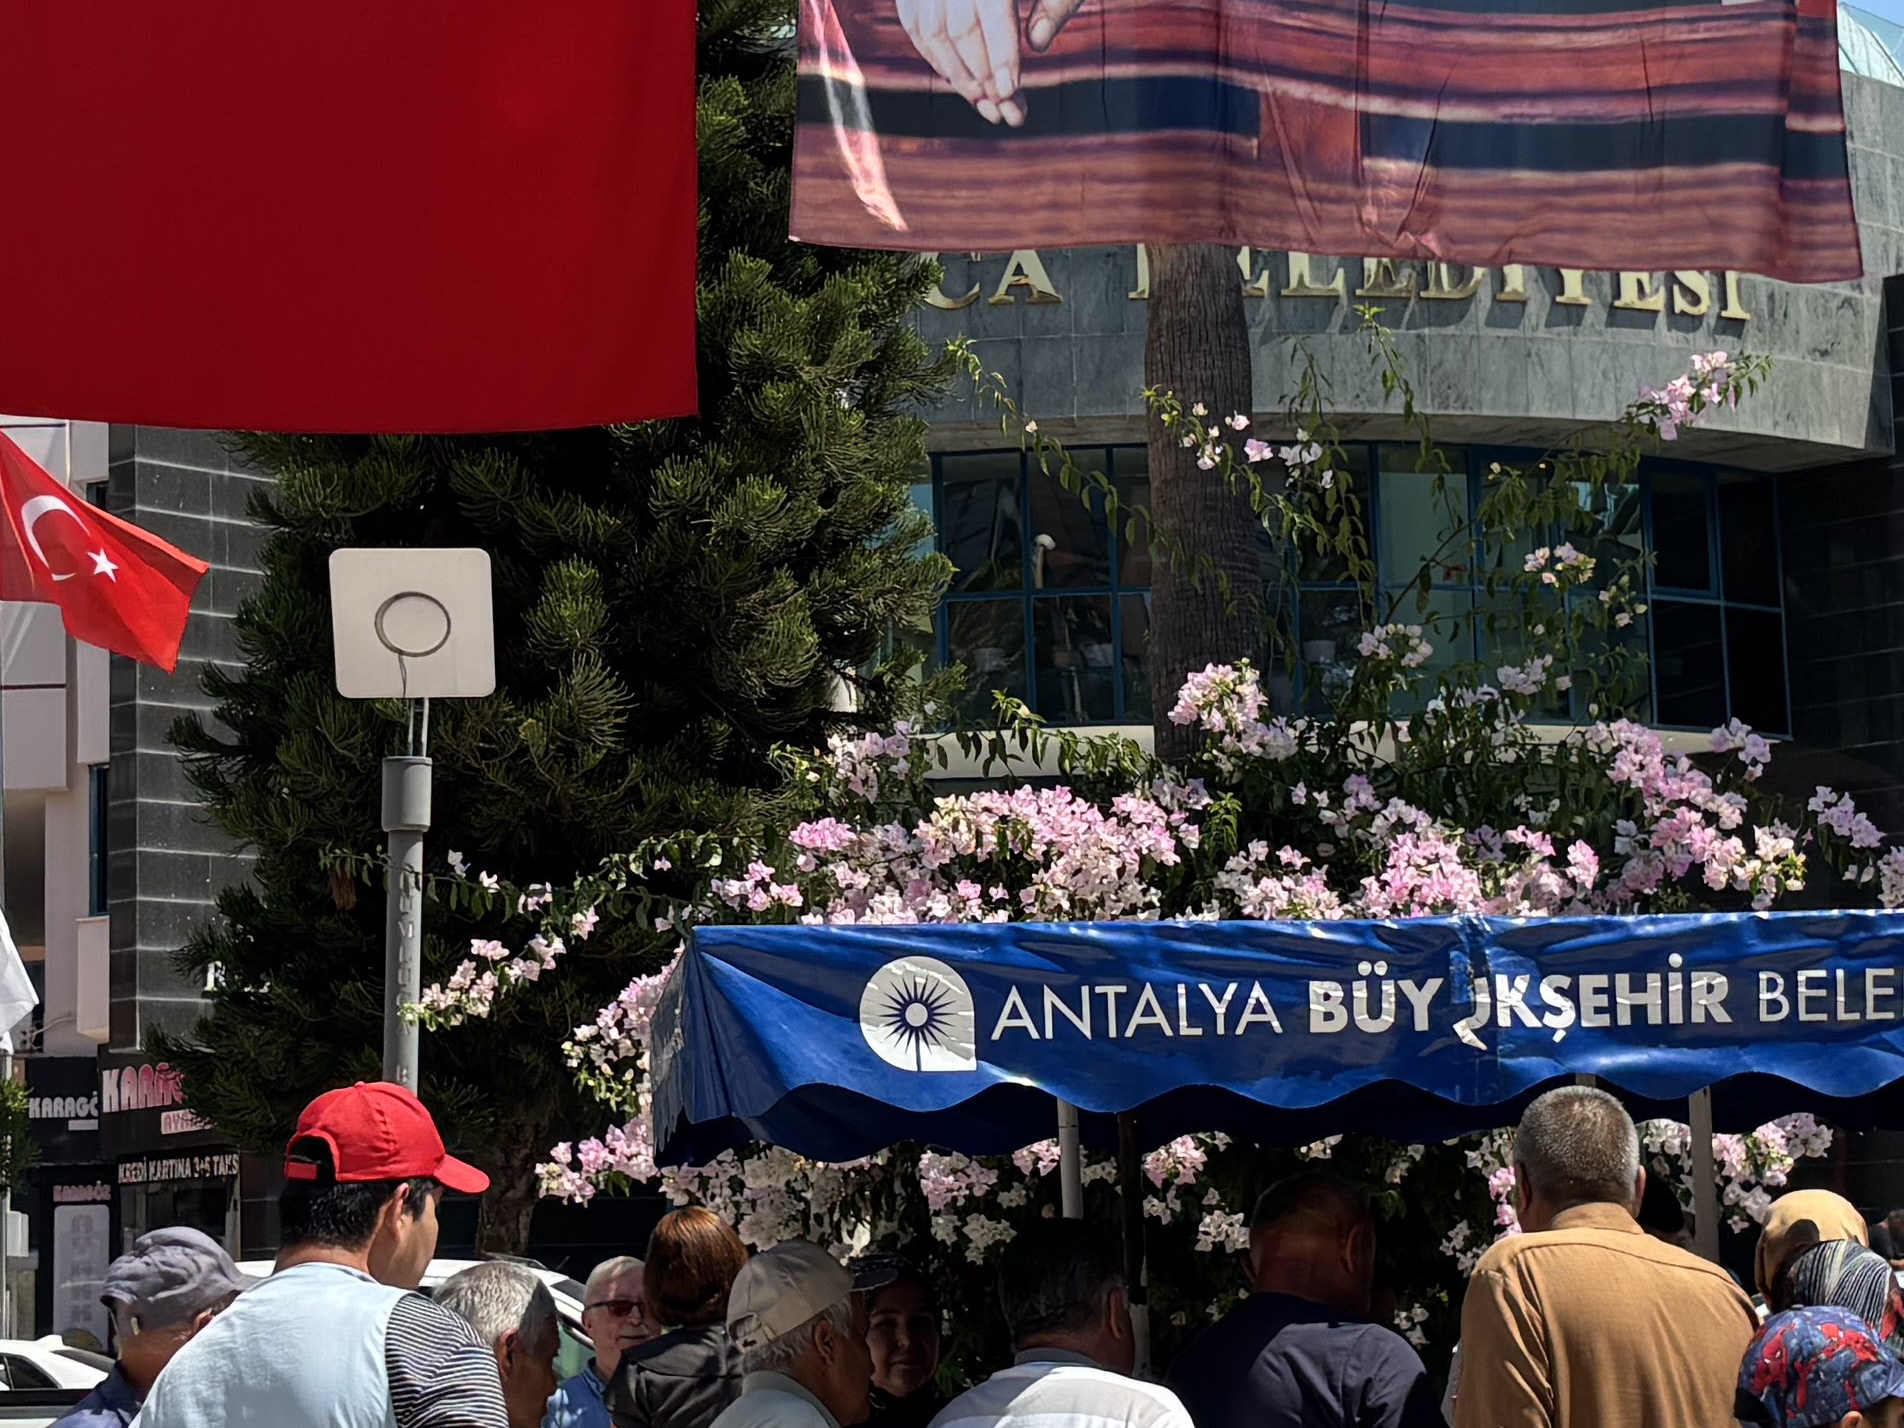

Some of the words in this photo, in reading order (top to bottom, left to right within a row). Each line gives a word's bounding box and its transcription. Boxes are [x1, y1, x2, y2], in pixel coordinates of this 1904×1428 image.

[990, 981, 1283, 1041] ANTALYA
[102, 1062, 187, 1113] KARA
[212, 1153, 240, 1176] TAKS
